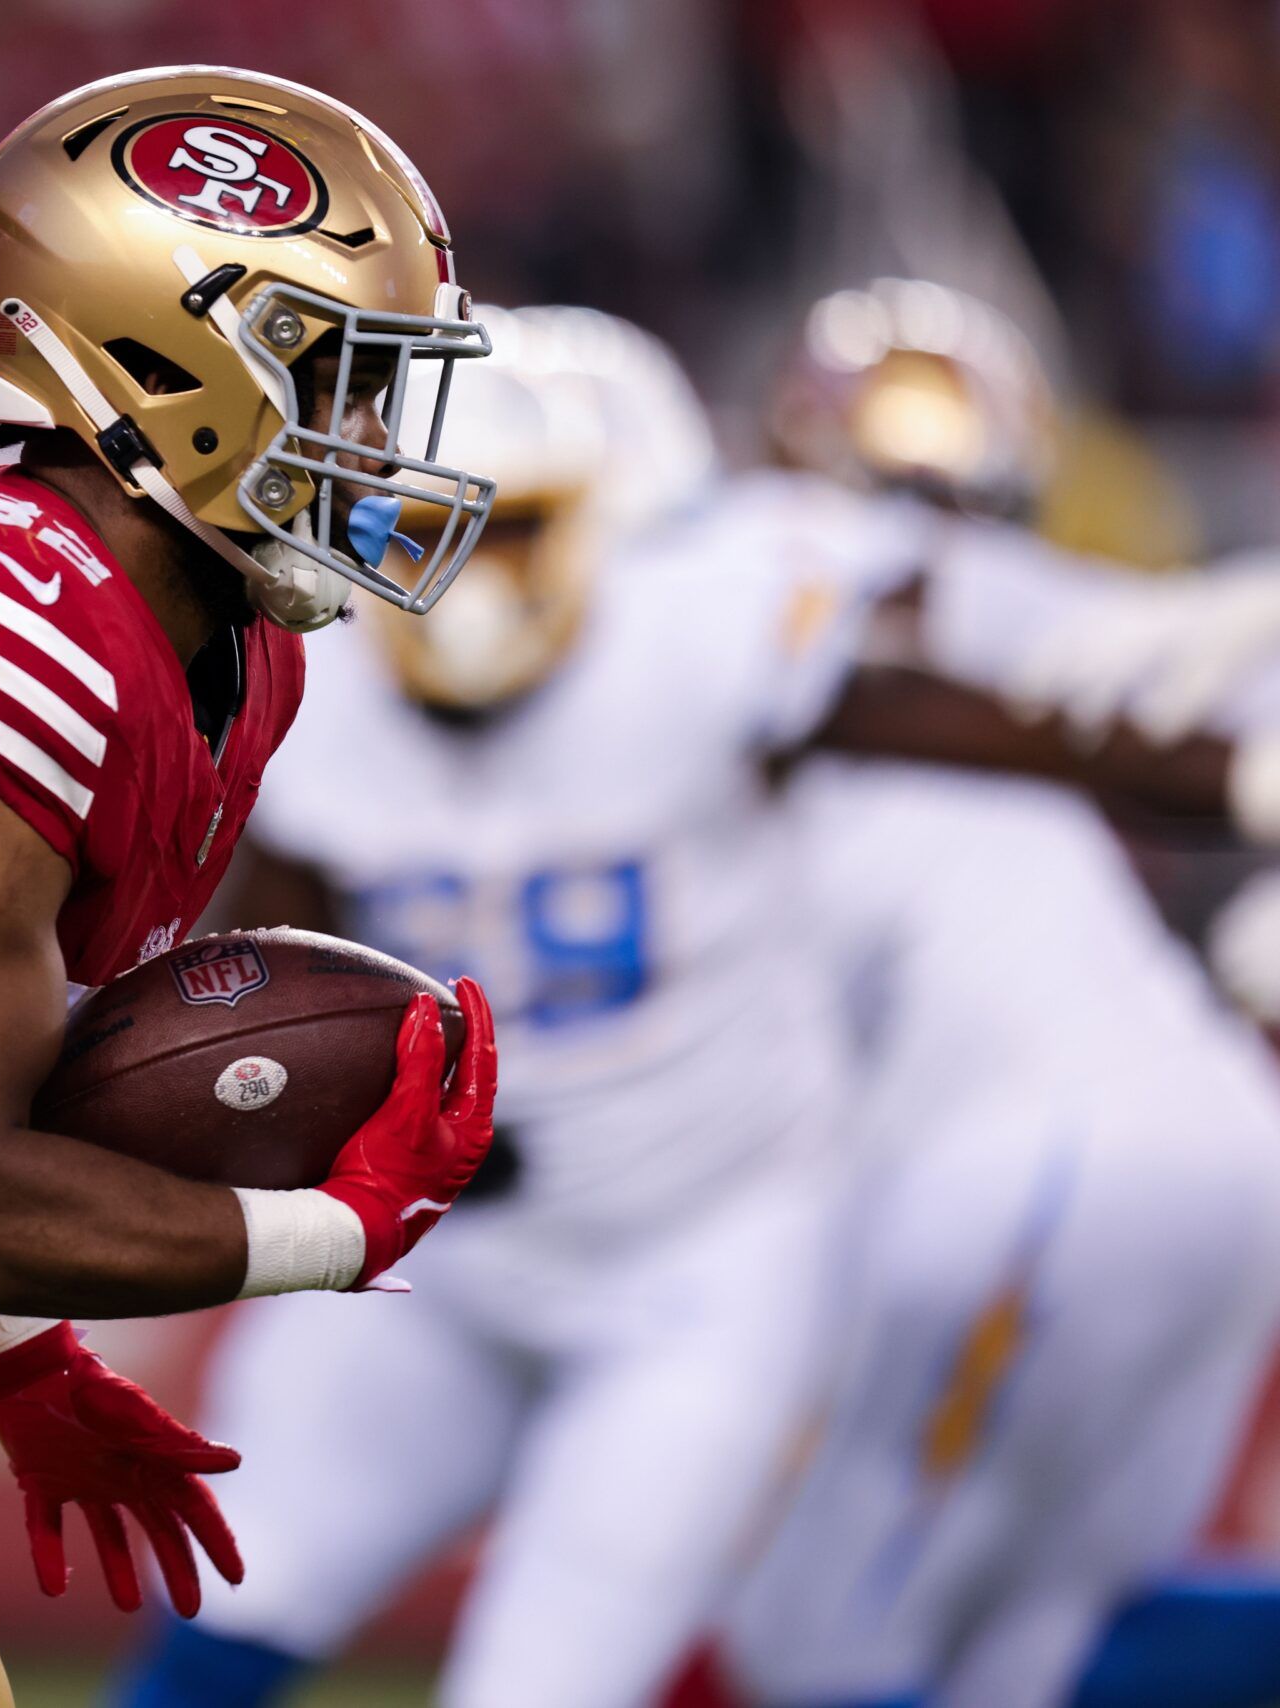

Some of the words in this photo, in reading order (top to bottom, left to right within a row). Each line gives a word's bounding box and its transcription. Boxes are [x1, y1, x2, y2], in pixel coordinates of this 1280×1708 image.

[168, 125, 292, 218] SF
[15, 312, 39, 333] 32
[183, 956, 259, 996] NFL
[238, 1077, 271, 1103] 290
